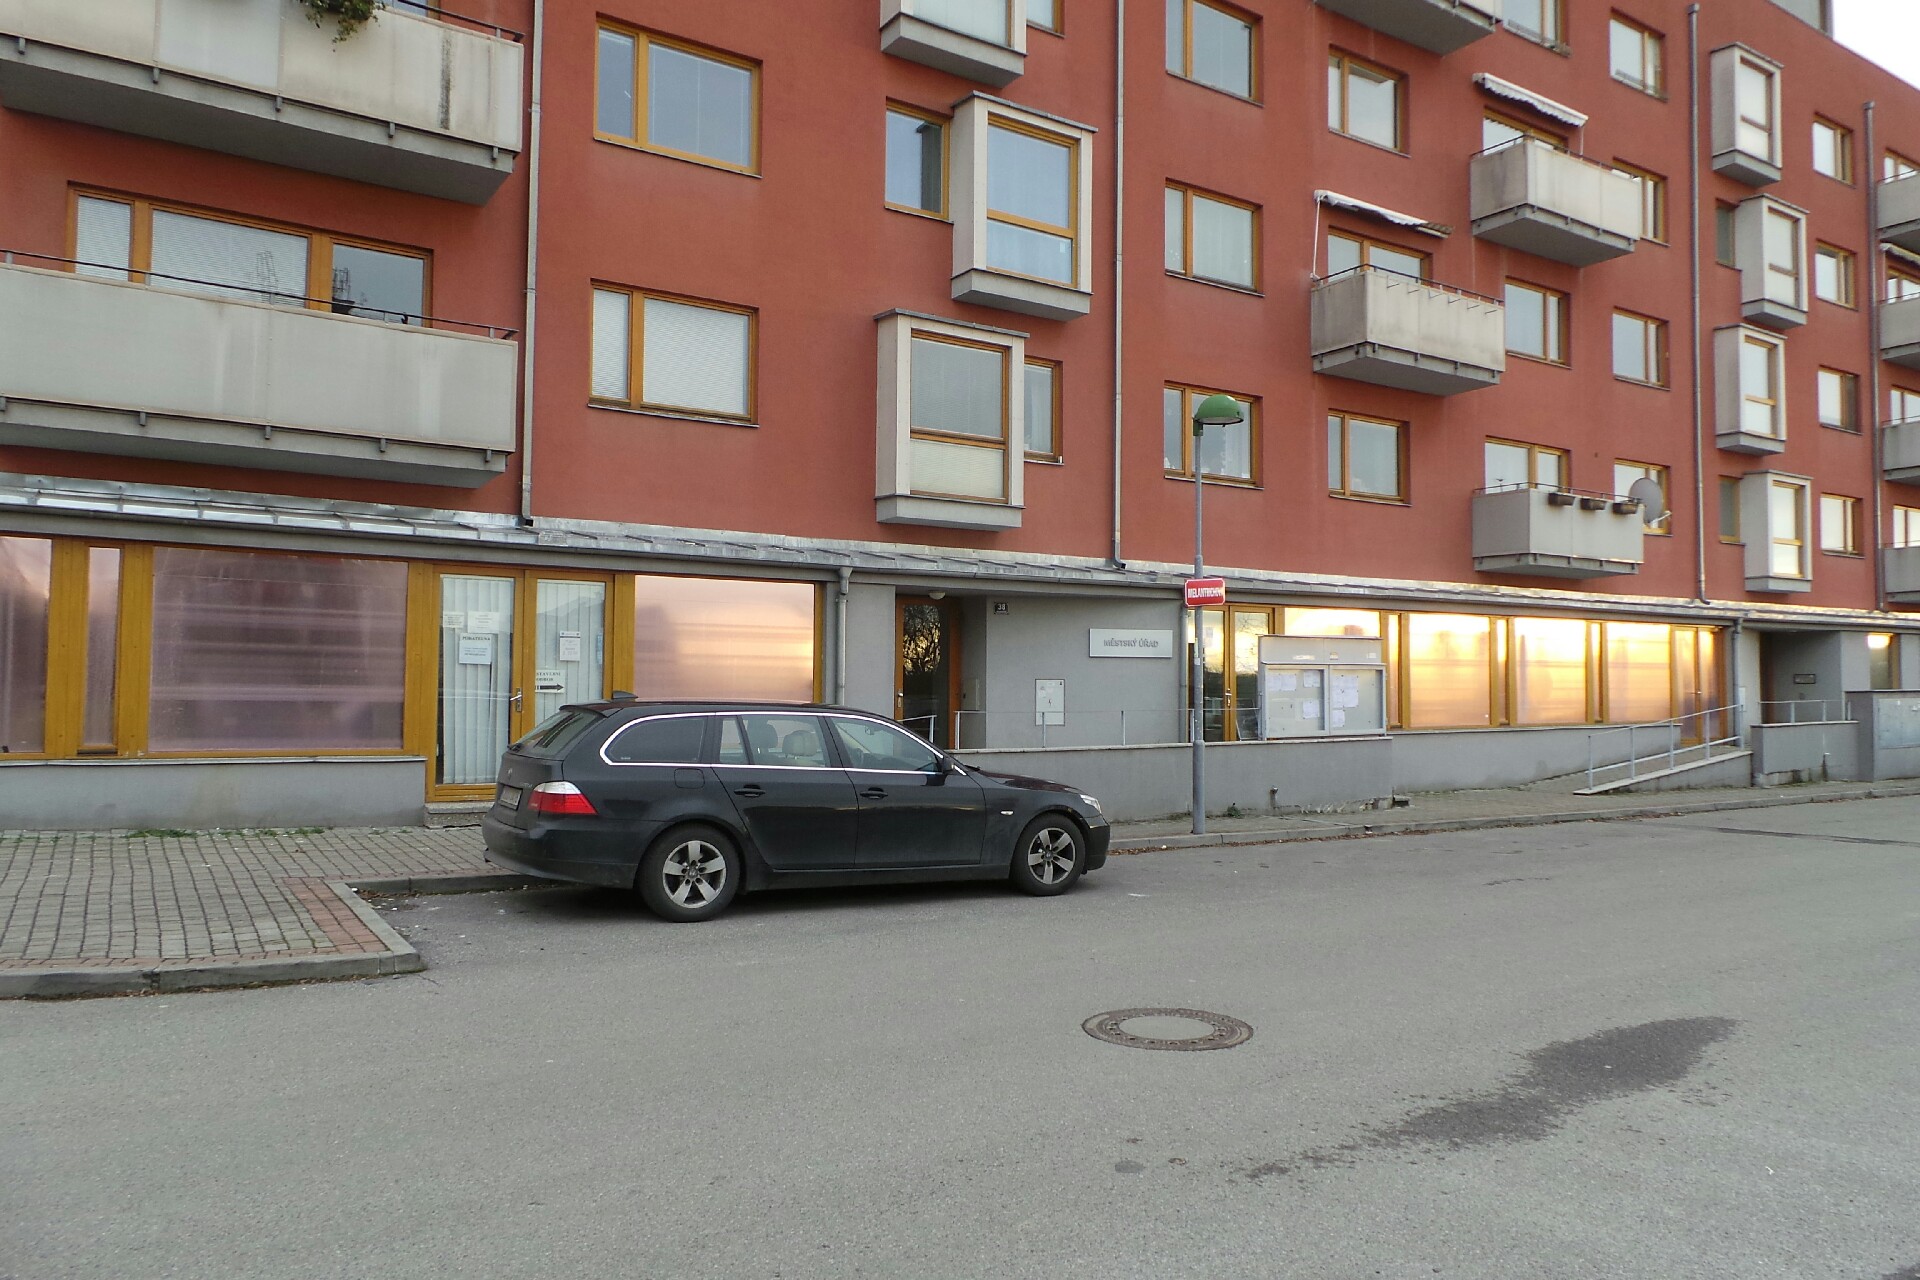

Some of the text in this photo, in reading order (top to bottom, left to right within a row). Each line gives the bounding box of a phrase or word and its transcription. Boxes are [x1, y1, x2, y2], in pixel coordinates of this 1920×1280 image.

[997, 603, 1006, 611] 38
[1103, 637, 1159, 648] MĚSTSKÝ ÚŘAD
